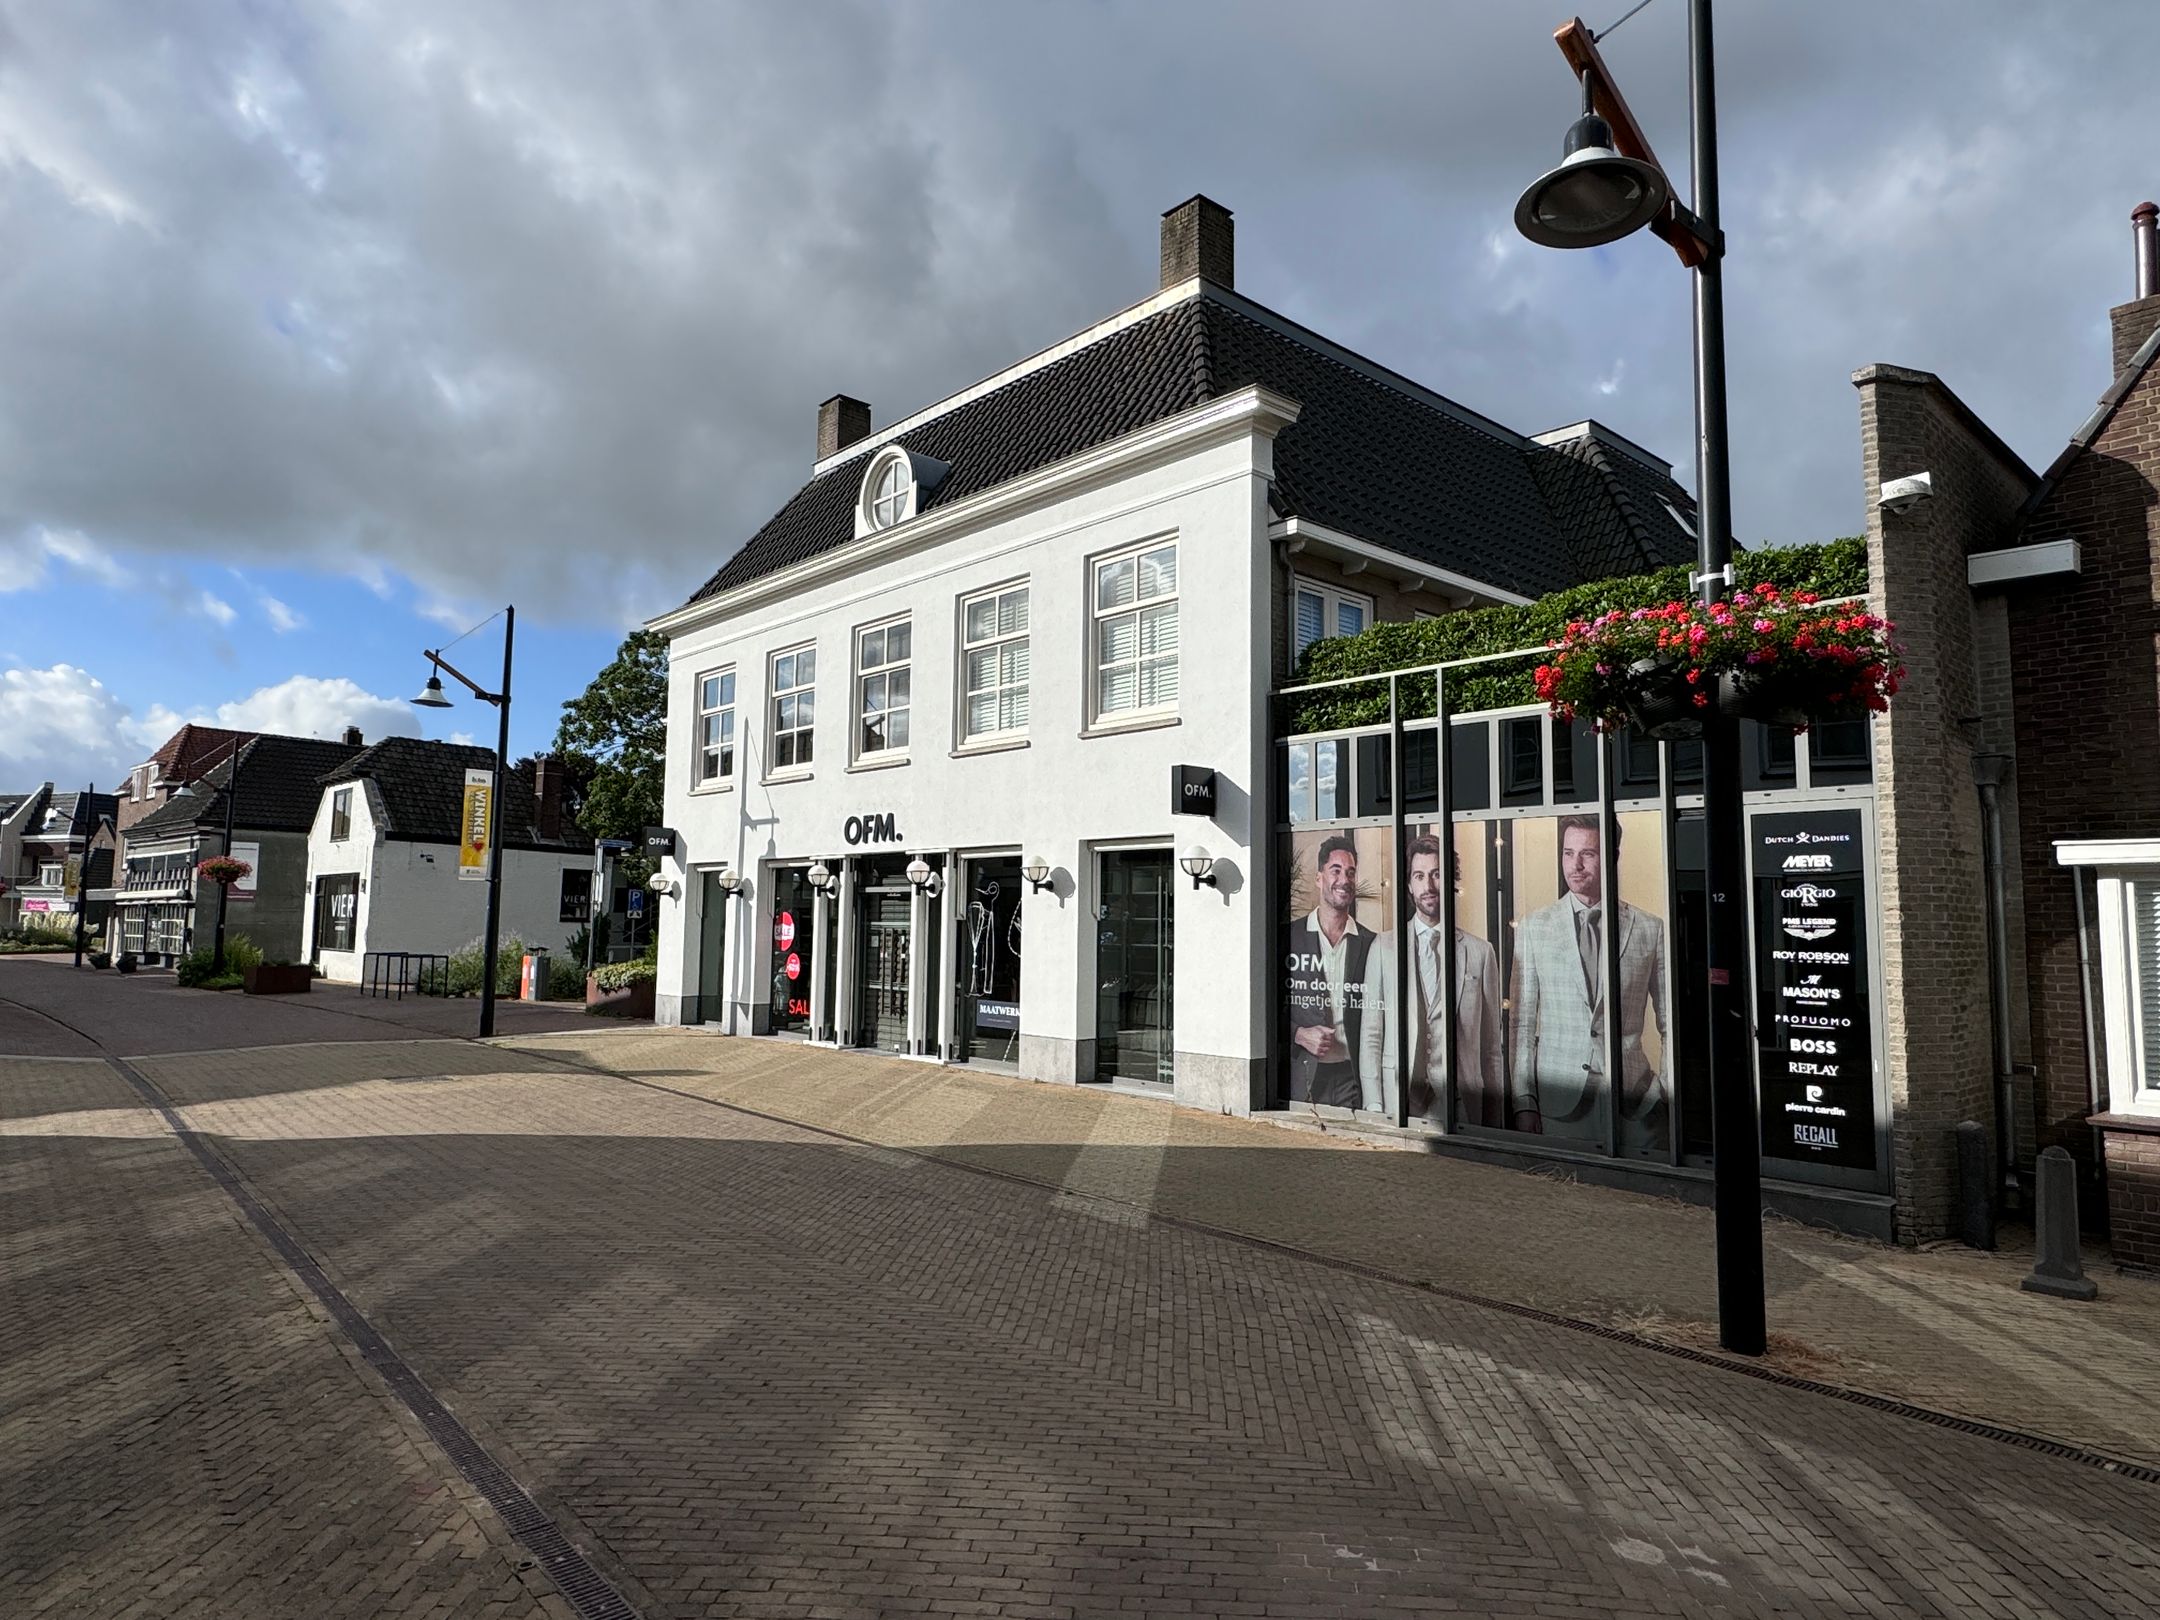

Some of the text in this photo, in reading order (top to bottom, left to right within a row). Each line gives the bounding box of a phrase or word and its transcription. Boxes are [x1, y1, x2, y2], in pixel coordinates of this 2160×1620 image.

[1184, 783, 1212, 798] OFM.
[473, 789, 487, 841] WINKEL
[843, 812, 903, 846] OFM.
[648, 837, 672, 846] OFM.
[1765, 834, 1850, 844] DUTCH DANDIES
[1781, 854, 1834, 868] MEYER
[563, 894, 587, 904] VIER
[1712, 893, 1726, 902] 12
[1780, 887, 1836, 904] GIORGIO
[331, 893, 354, 918] VIER
[1802, 917, 1837, 926] LEGEND
[775, 927, 791, 936] SALE
[1772, 950, 1849, 961] ROY ROBSON
[1285, 977, 1369, 993] Om door een
[1782, 986, 1842, 1000] MASON'S
[788, 999, 811, 1015] SAL
[1774, 1014, 1852, 1027] PROFUOMO
[1789, 1038, 1837, 1055] BOSS
[1788, 1061, 1840, 1077] REPLAY
[1784, 1102, 1847, 1117] pierre cardin
